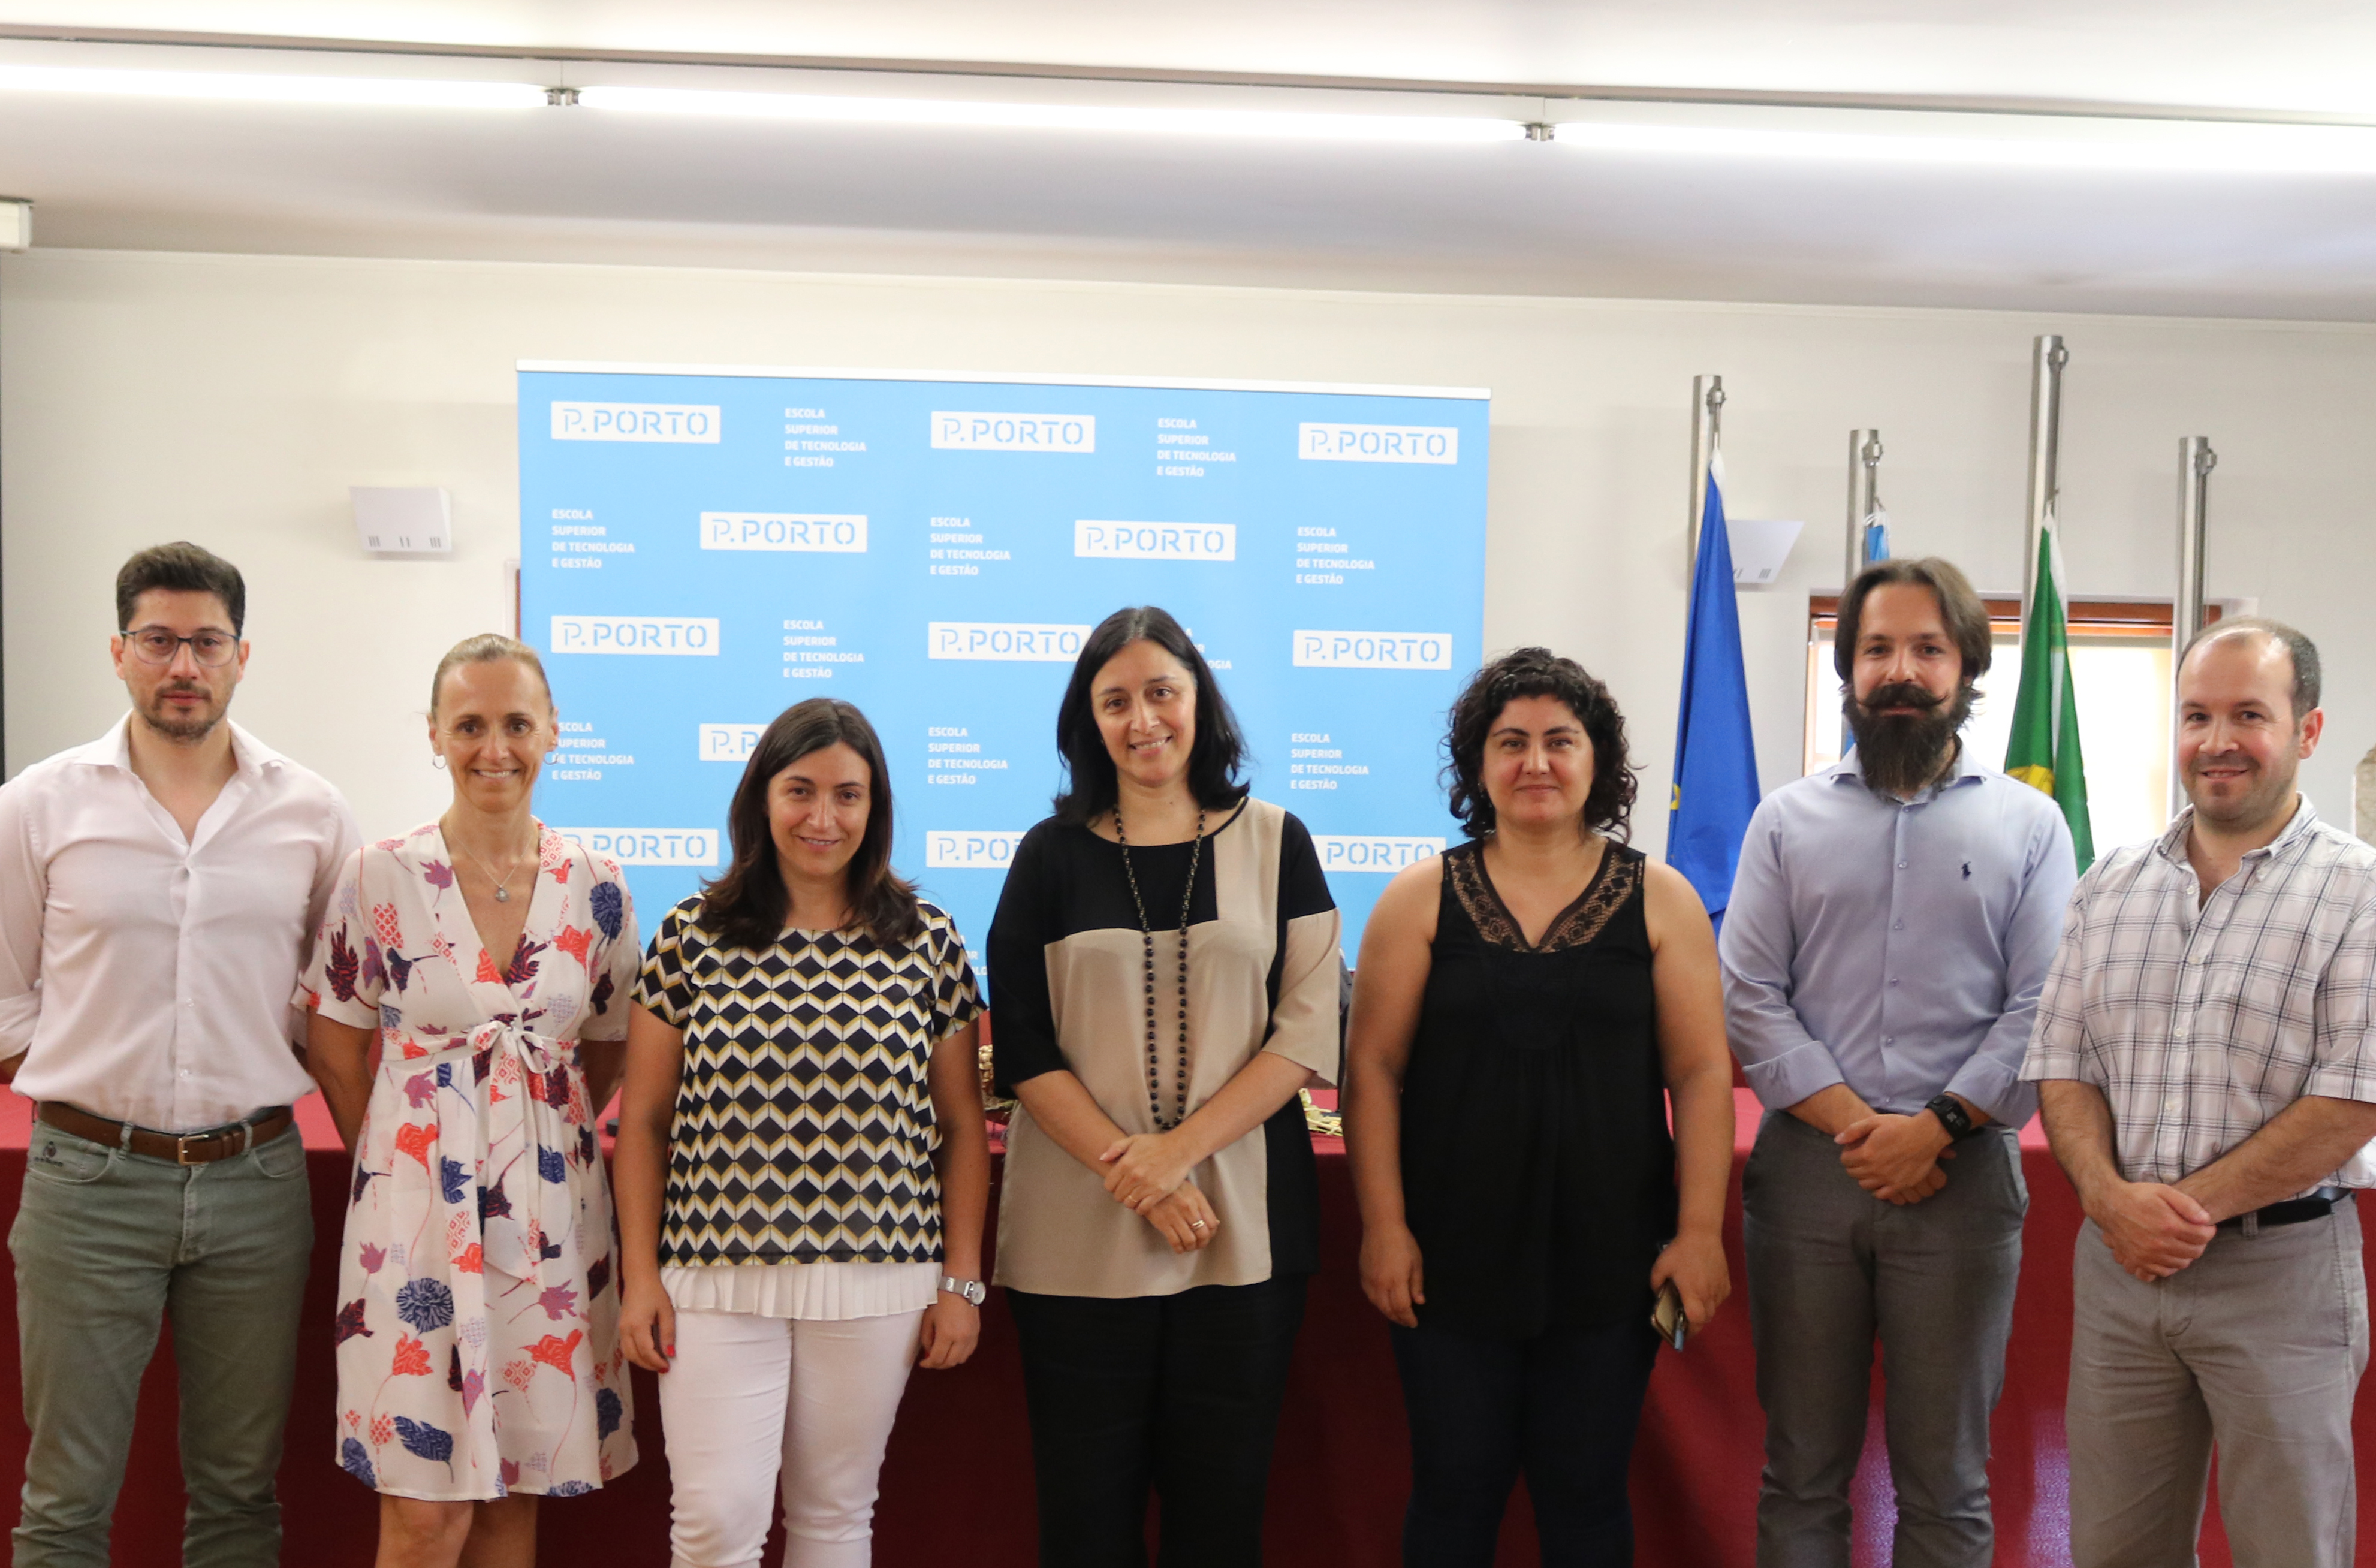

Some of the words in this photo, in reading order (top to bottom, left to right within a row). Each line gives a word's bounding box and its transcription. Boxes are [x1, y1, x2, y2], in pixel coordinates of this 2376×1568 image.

[785, 408, 826, 418] ESCOLA
[562, 408, 708, 436] P.PORTO
[1157, 418, 1198, 429] ESCOLA
[785, 424, 839, 435] SUPERIOR
[943, 418, 1084, 445] P.PORTO
[1157, 434, 1210, 445] SUPERIOR
[1310, 429, 1446, 457] P.PORTO
[784, 440, 800, 450] DE
[800, 441, 867, 451] TECNOLOGIA
[784, 456, 792, 466] E
[792, 455, 834, 467] GESTÃO
[1157, 450, 1171, 460] DE
[1172, 450, 1237, 462] TECNOLOGIA
[1156, 466, 1164, 476] E
[1165, 465, 1205, 477] GESTÃO
[551, 509, 594, 520] ESCOLA
[930, 517, 971, 527] ESCOLA
[551, 525, 607, 536] SUPERIOR
[711, 518, 856, 545] P.PORTO
[1297, 527, 1337, 537] ESCOLA
[930, 533, 984, 544] SUPERIOR
[1086, 527, 1225, 553] P.PORTO
[551, 541, 567, 552] DE
[568, 542, 636, 553] TECNOLOGIA
[1296, 542, 1349, 553] SUPERIOR
[930, 549, 945, 559] DE
[946, 549, 1011, 560] TECNOLOGIA
[551, 557, 559, 568] E
[560, 556, 603, 569] GESTÃO
[1296, 558, 1311, 568] DE
[1312, 559, 1376, 569] TECNOLOGIA
[930, 565, 937, 575] E
[938, 564, 979, 575] GESTÃO
[1295, 574, 1303, 584] E
[1304, 572, 1344, 584] GESTÃO
[783, 620, 825, 630] ESCOLA
[562, 622, 708, 648] P.PORTO
[783, 636, 837, 646] SUPERIOR
[940, 628, 1081, 655] P.PORTO
[1305, 636, 1441, 662] P.PORTO
[783, 652, 798, 662] DE
[799, 652, 865, 662] TECNOLOGIA
[783, 668, 791, 677] E
[791, 666, 833, 678] GESTÃO
[558, 722, 593, 732] SCOLA
[928, 726, 969, 737] ESCOLA
[557, 737, 607, 749] UPERIOR
[1290, 732, 1331, 743] ESCOLA
[928, 743, 981, 753] SUPERIOR
[1290, 748, 1343, 759] SUPERIOR
[568, 753, 635, 765] TECNOLOGIA
[927, 759, 942, 768] DE
[943, 759, 1009, 769] TECNOLOGIA
[551, 770, 559, 781] E
[560, 767, 603, 781] GESTÃO
[1290, 764, 1304, 774] DE
[1305, 764, 1370, 775] TECNOLOGIA
[927, 774, 935, 784] E
[936, 773, 977, 785] GESTÃO
[1290, 780, 1297, 789] E
[1298, 778, 1338, 790] GESTÃO
